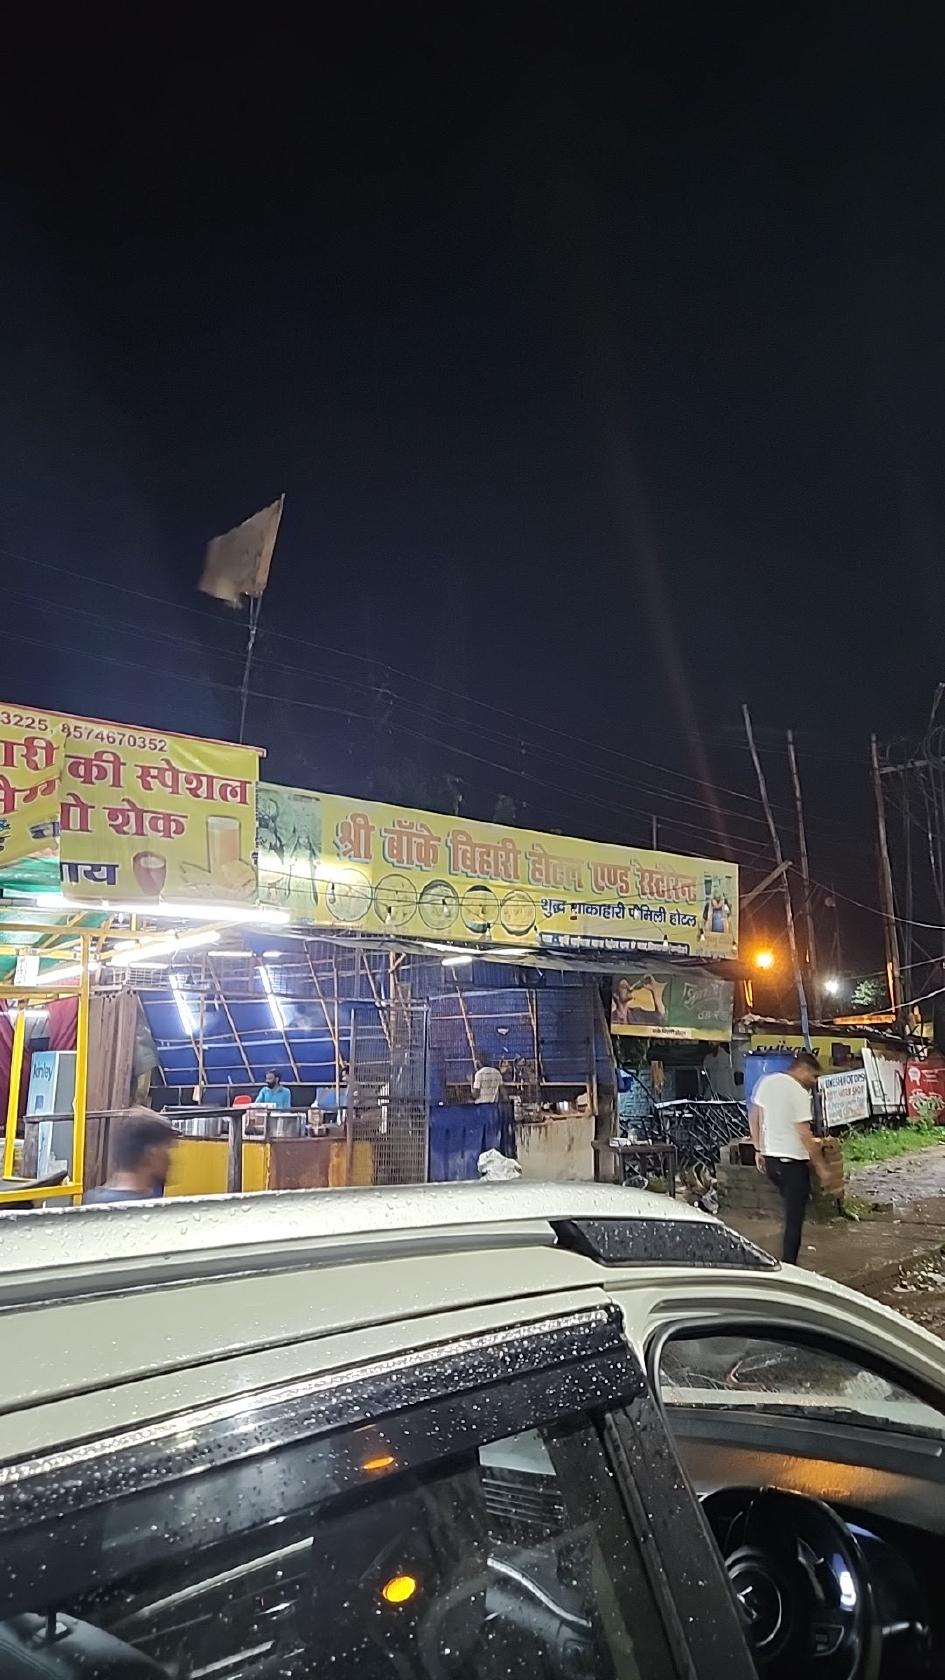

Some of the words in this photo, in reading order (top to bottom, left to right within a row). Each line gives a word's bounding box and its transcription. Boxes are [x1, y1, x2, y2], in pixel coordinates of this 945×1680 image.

[61, 722, 168, 753] 8574670352
[65, 750, 126, 790] की
[134, 758, 252, 806] स्पेशल
[103, 798, 189, 840] शेक
[334, 811, 375, 864] श्री
[447, 829, 521, 884] बिहारी
[525, 843, 585, 892] होटल
[587, 861, 631, 898] एण्ड
[669, 909, 698, 928] होटल
